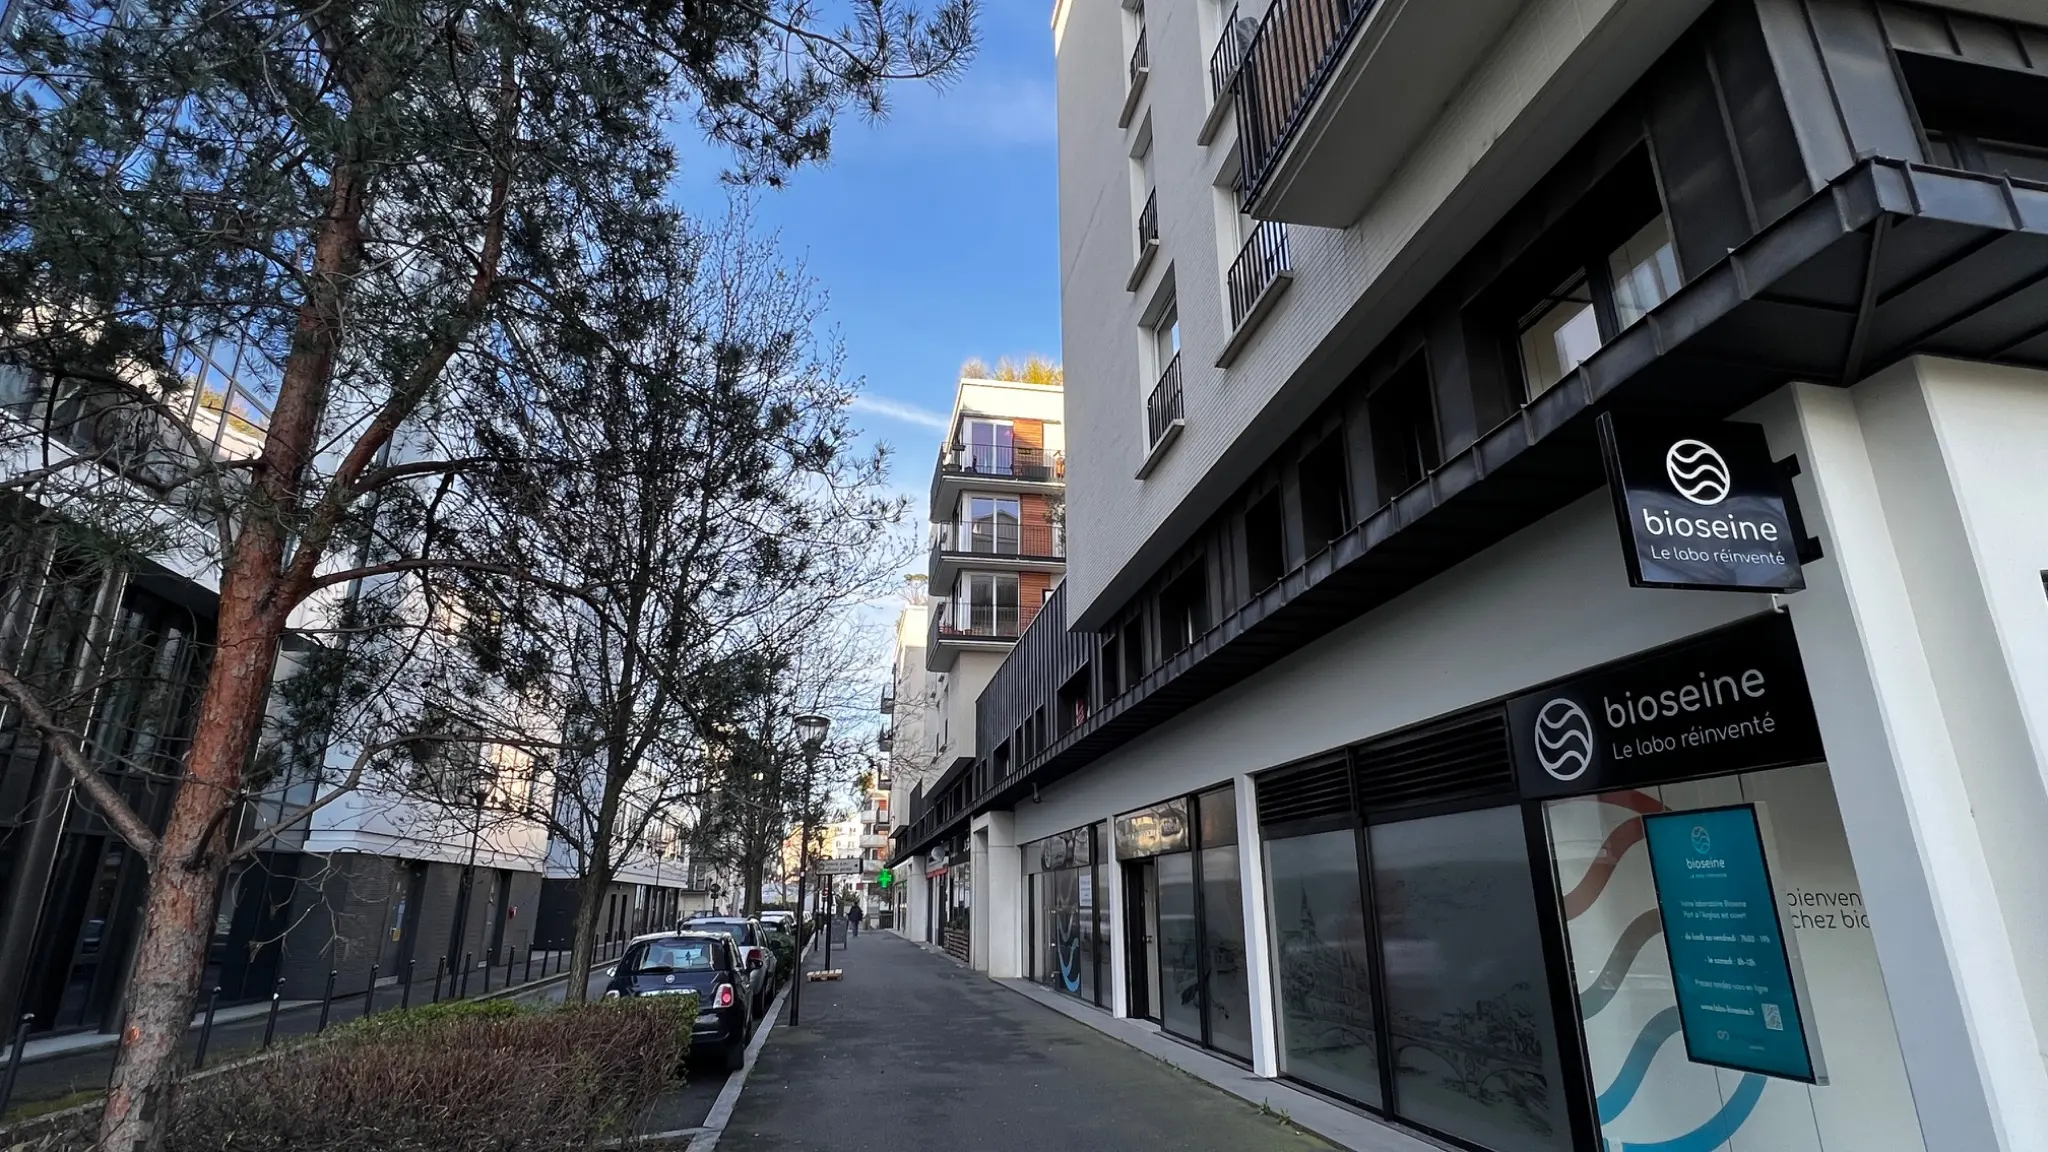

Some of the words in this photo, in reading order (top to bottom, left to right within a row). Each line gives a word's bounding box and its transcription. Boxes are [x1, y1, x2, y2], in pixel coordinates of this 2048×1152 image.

[1642, 508, 1778, 541] bioseine
[1651, 546, 1670, 560] Le
[1673, 546, 1710, 562] labo
[1714, 549, 1786, 565] réinventé
[1604, 669, 1766, 728] bioseine
[1612, 743, 1633, 760] Le
[1636, 735, 1676, 755] labo
[1681, 711, 1776, 748] réinventé
[1686, 857, 1726, 869] bioseine
[1791, 909, 1837, 929] chez
